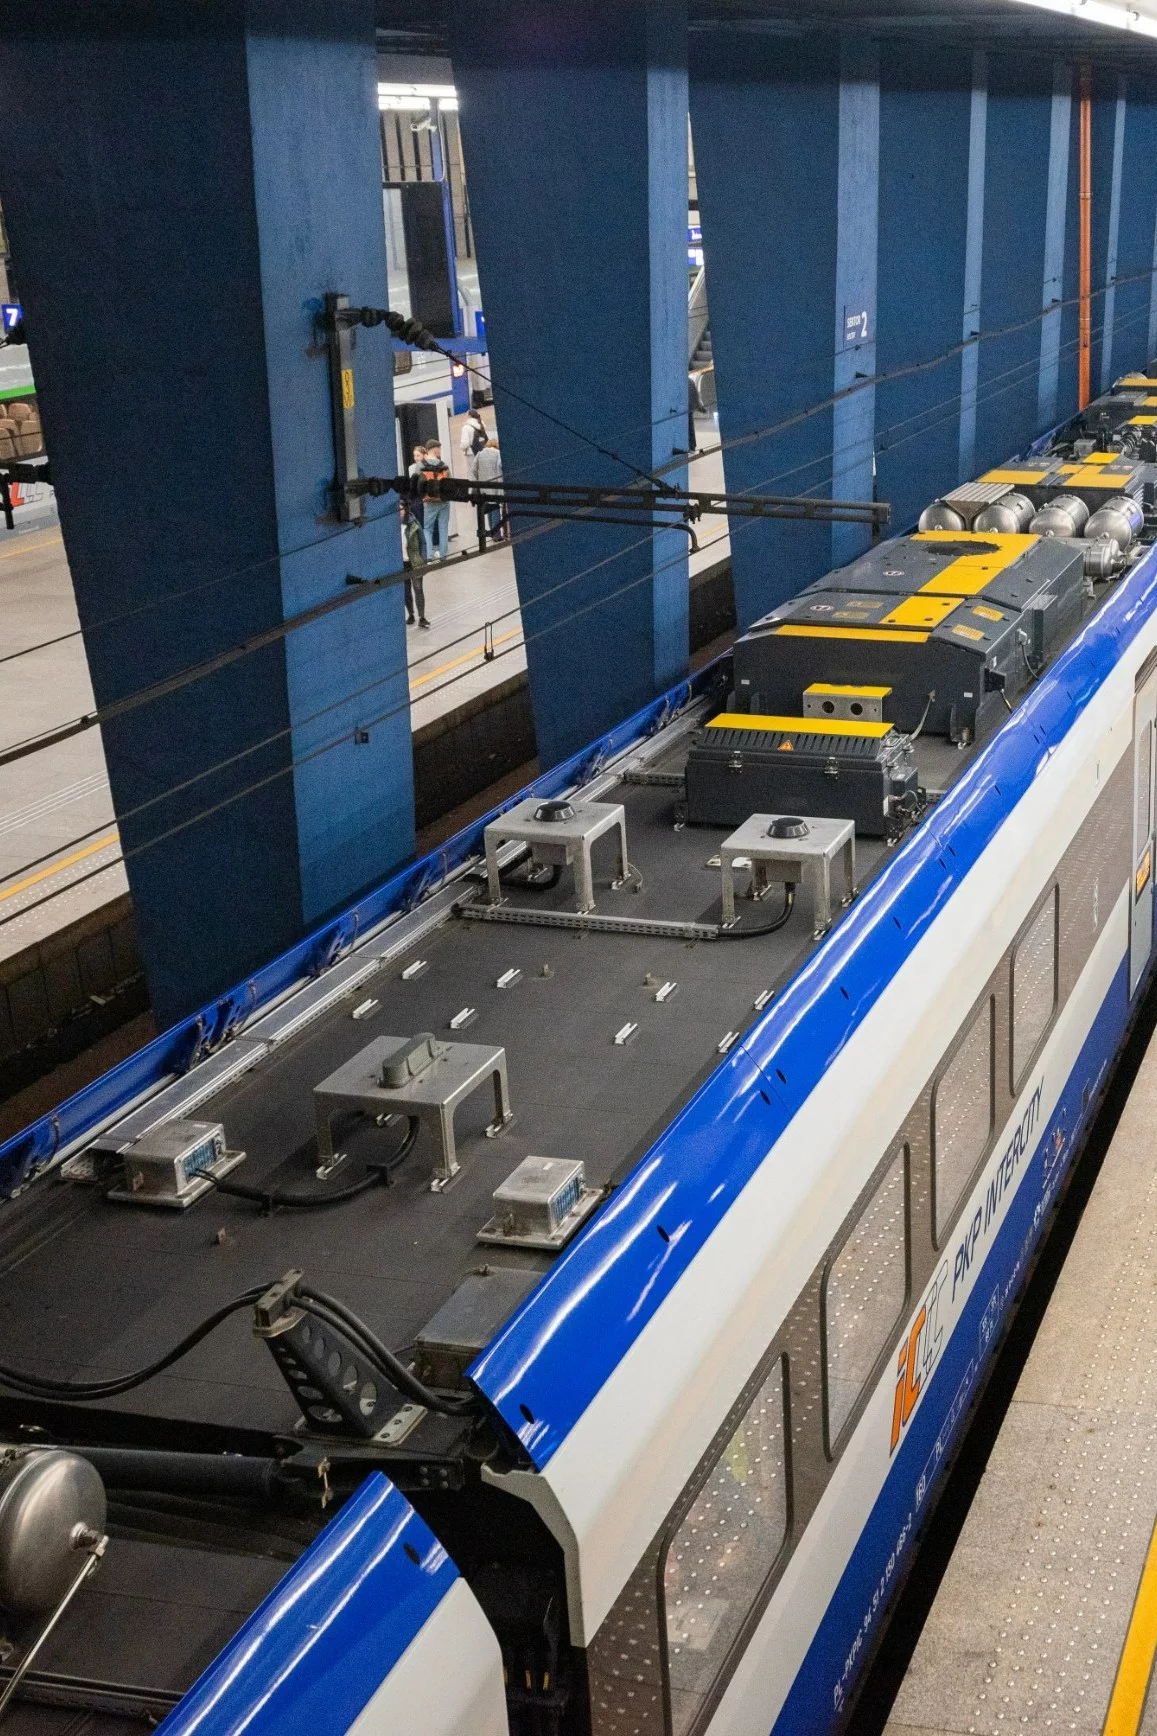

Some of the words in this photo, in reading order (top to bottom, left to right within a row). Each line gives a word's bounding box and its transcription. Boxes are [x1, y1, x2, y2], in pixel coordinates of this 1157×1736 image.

[5, 307, 19, 327] 7
[860, 310, 868, 338] 2
[952, 1206, 983, 1304] PKP
[984, 1075, 1045, 1235] INTERCITY
